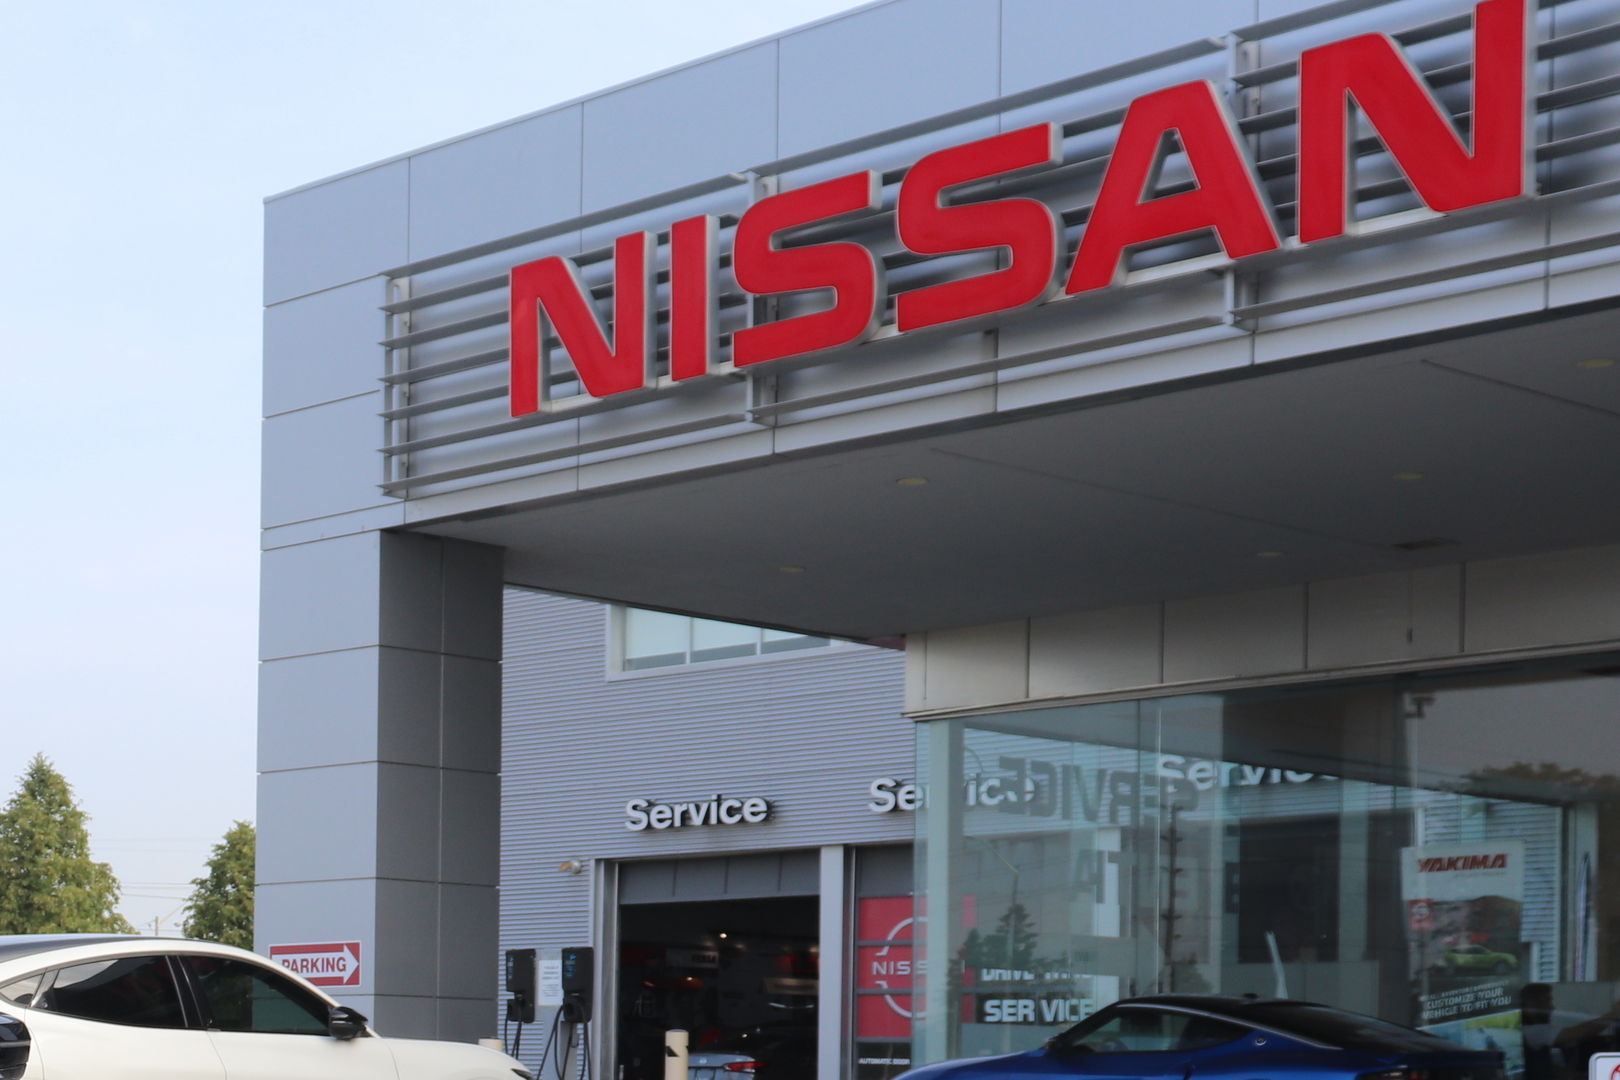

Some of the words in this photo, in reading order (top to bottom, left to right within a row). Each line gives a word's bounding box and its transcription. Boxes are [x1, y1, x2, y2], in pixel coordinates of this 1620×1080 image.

[510, 0, 1535, 418] NISSAN
[1156, 755, 1340, 792] Serv
[869, 773, 1036, 813] Seic
[625, 794, 769, 831] Service
[1418, 853, 1509, 873] YAKIMA
[282, 957, 347, 973] PARKING
[872, 960, 966, 975] NISS
[1422, 1005, 1459, 1019] VEHICLE
[1461, 1003, 1474, 1013] TO
[1475, 1000, 1489, 1010] FIT
[1491, 996, 1512, 1006] YOU
[1425, 993, 1476, 1009] CUSTOMIZE
[1478, 987, 1504, 999] YOUR
[983, 998, 1095, 1023] SERVICE
[858, 1057, 892, 1065] AUTOMATIC
[893, 1057, 911, 1065] DOOR
